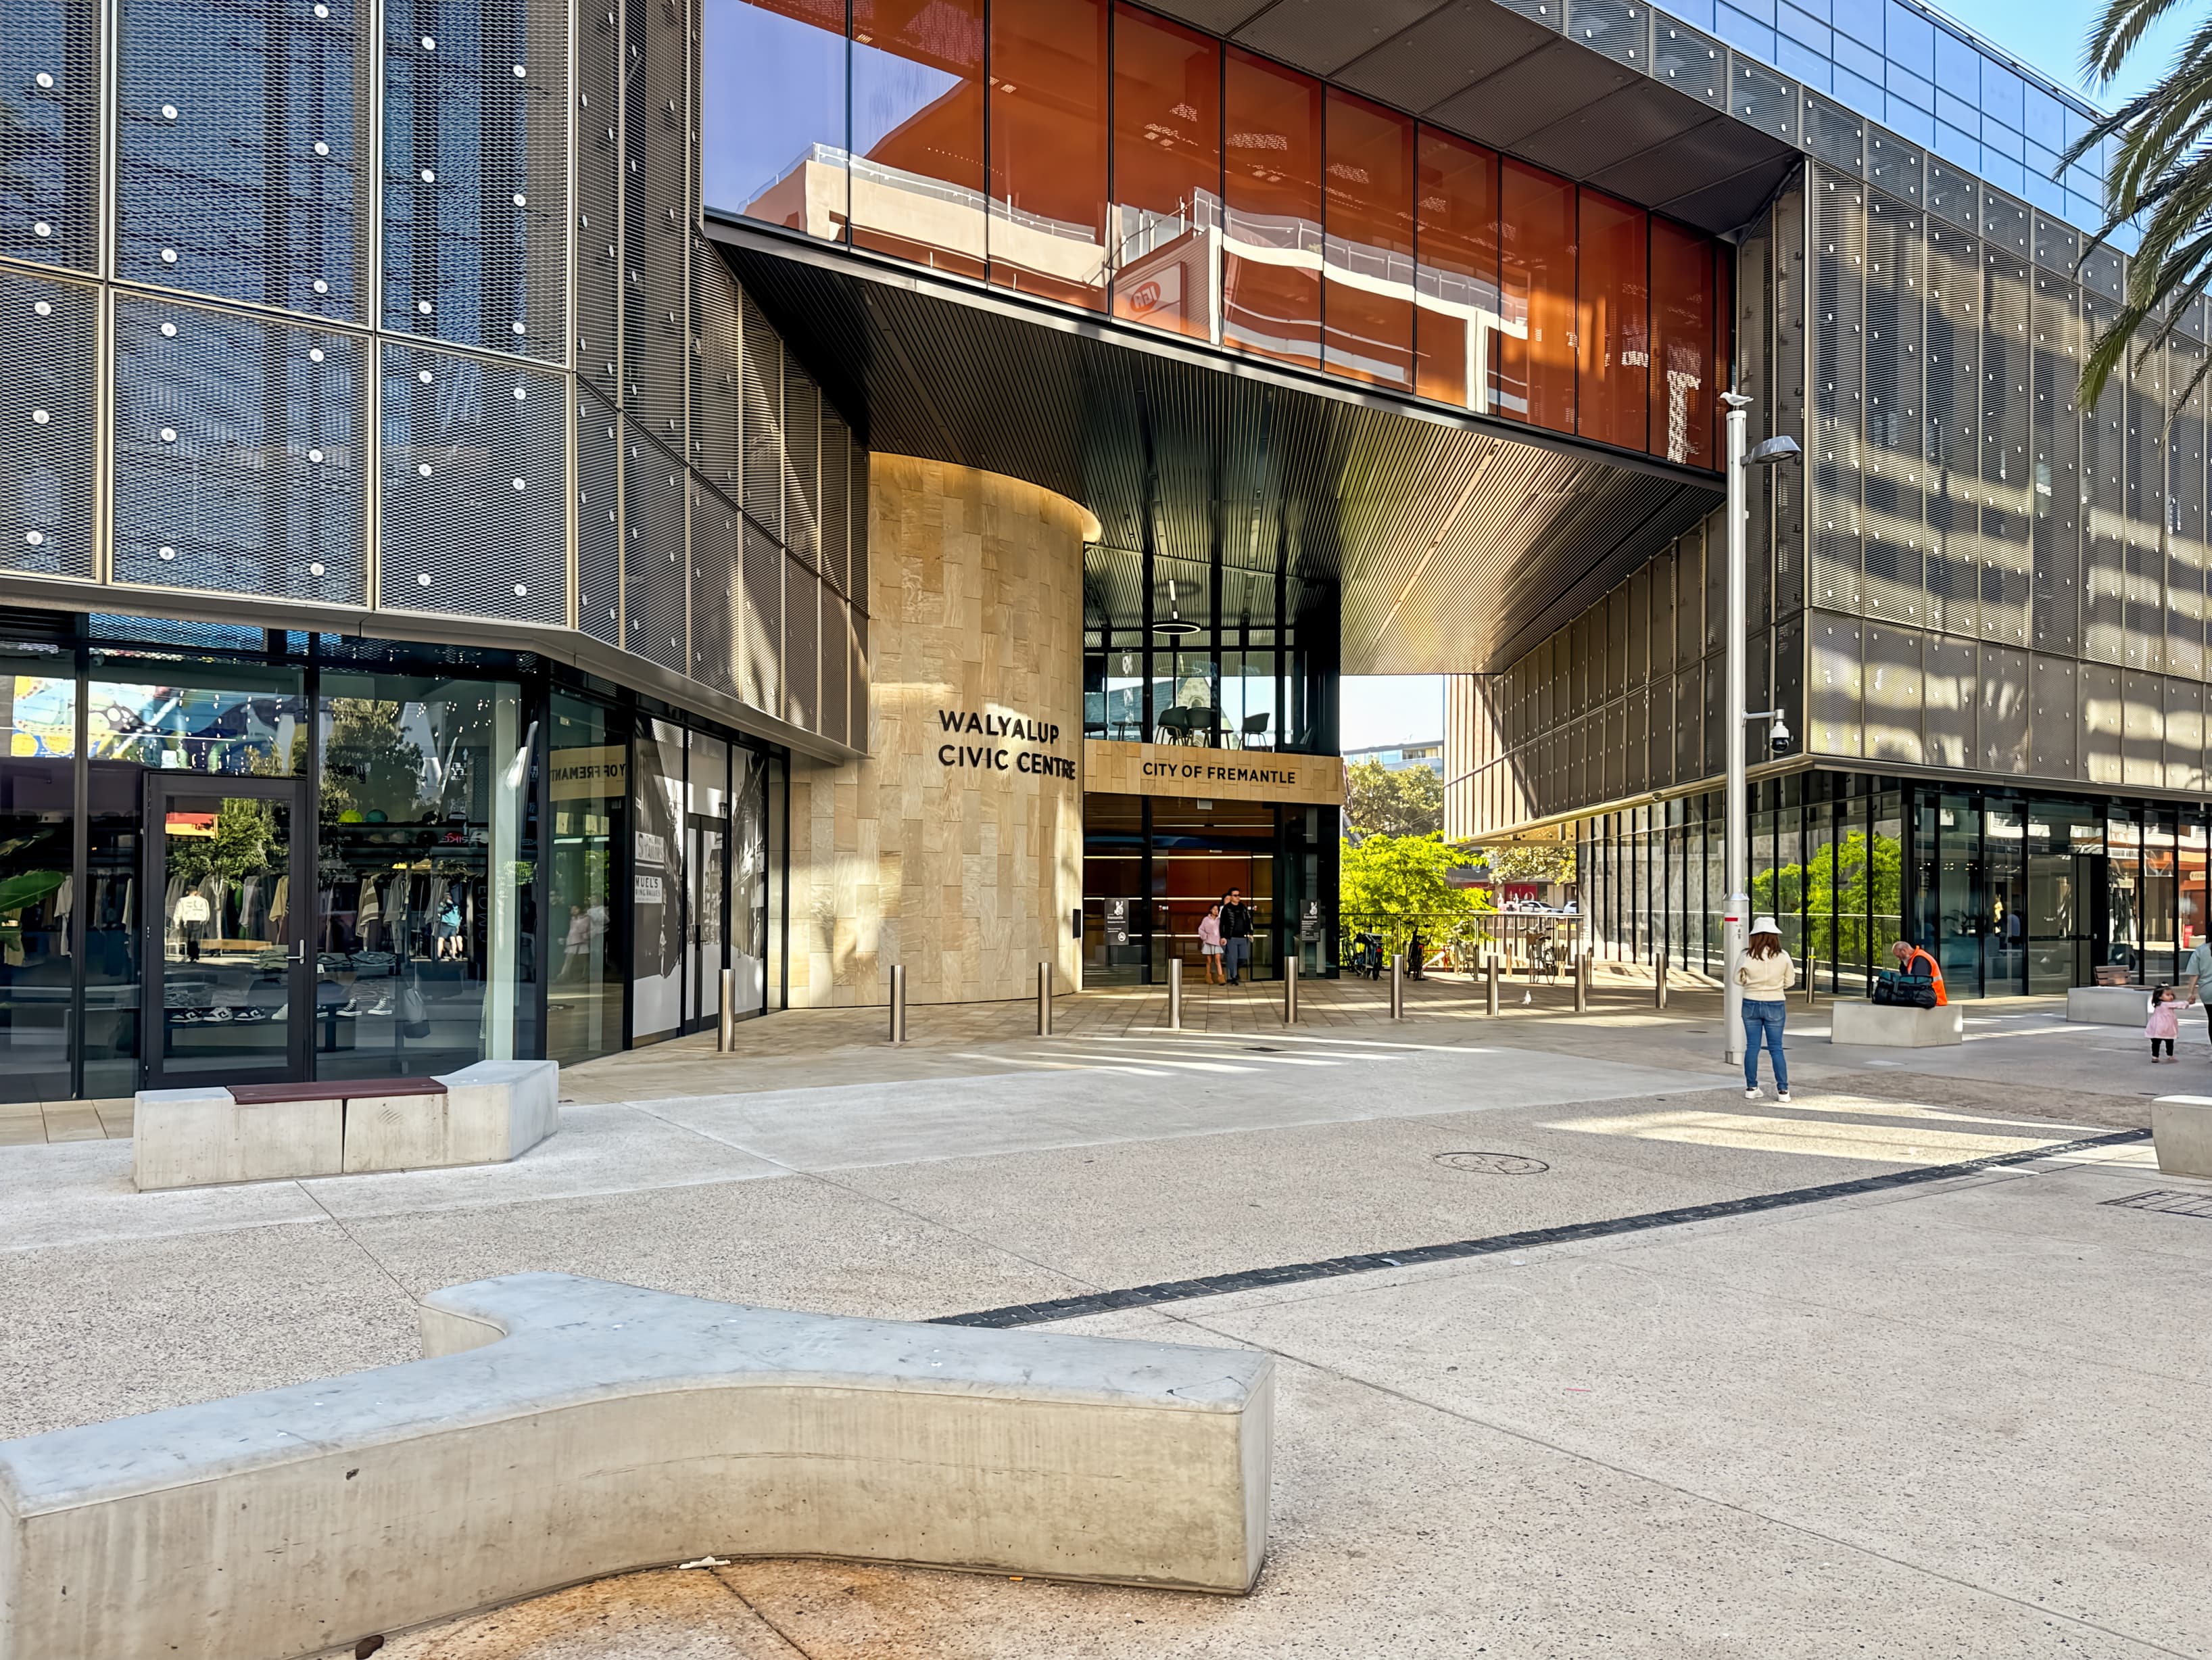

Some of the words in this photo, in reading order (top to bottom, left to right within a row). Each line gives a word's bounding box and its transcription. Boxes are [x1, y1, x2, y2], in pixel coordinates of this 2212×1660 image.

[939, 710, 1059, 744] WALYALUP
[938, 744, 1009, 770] CIVIC
[1017, 752, 1076, 780] CENTRE
[1143, 762, 1178, 777] CITY
[1182, 765, 1203, 778] OF
[1207, 766, 1296, 784] FREMANTLE
